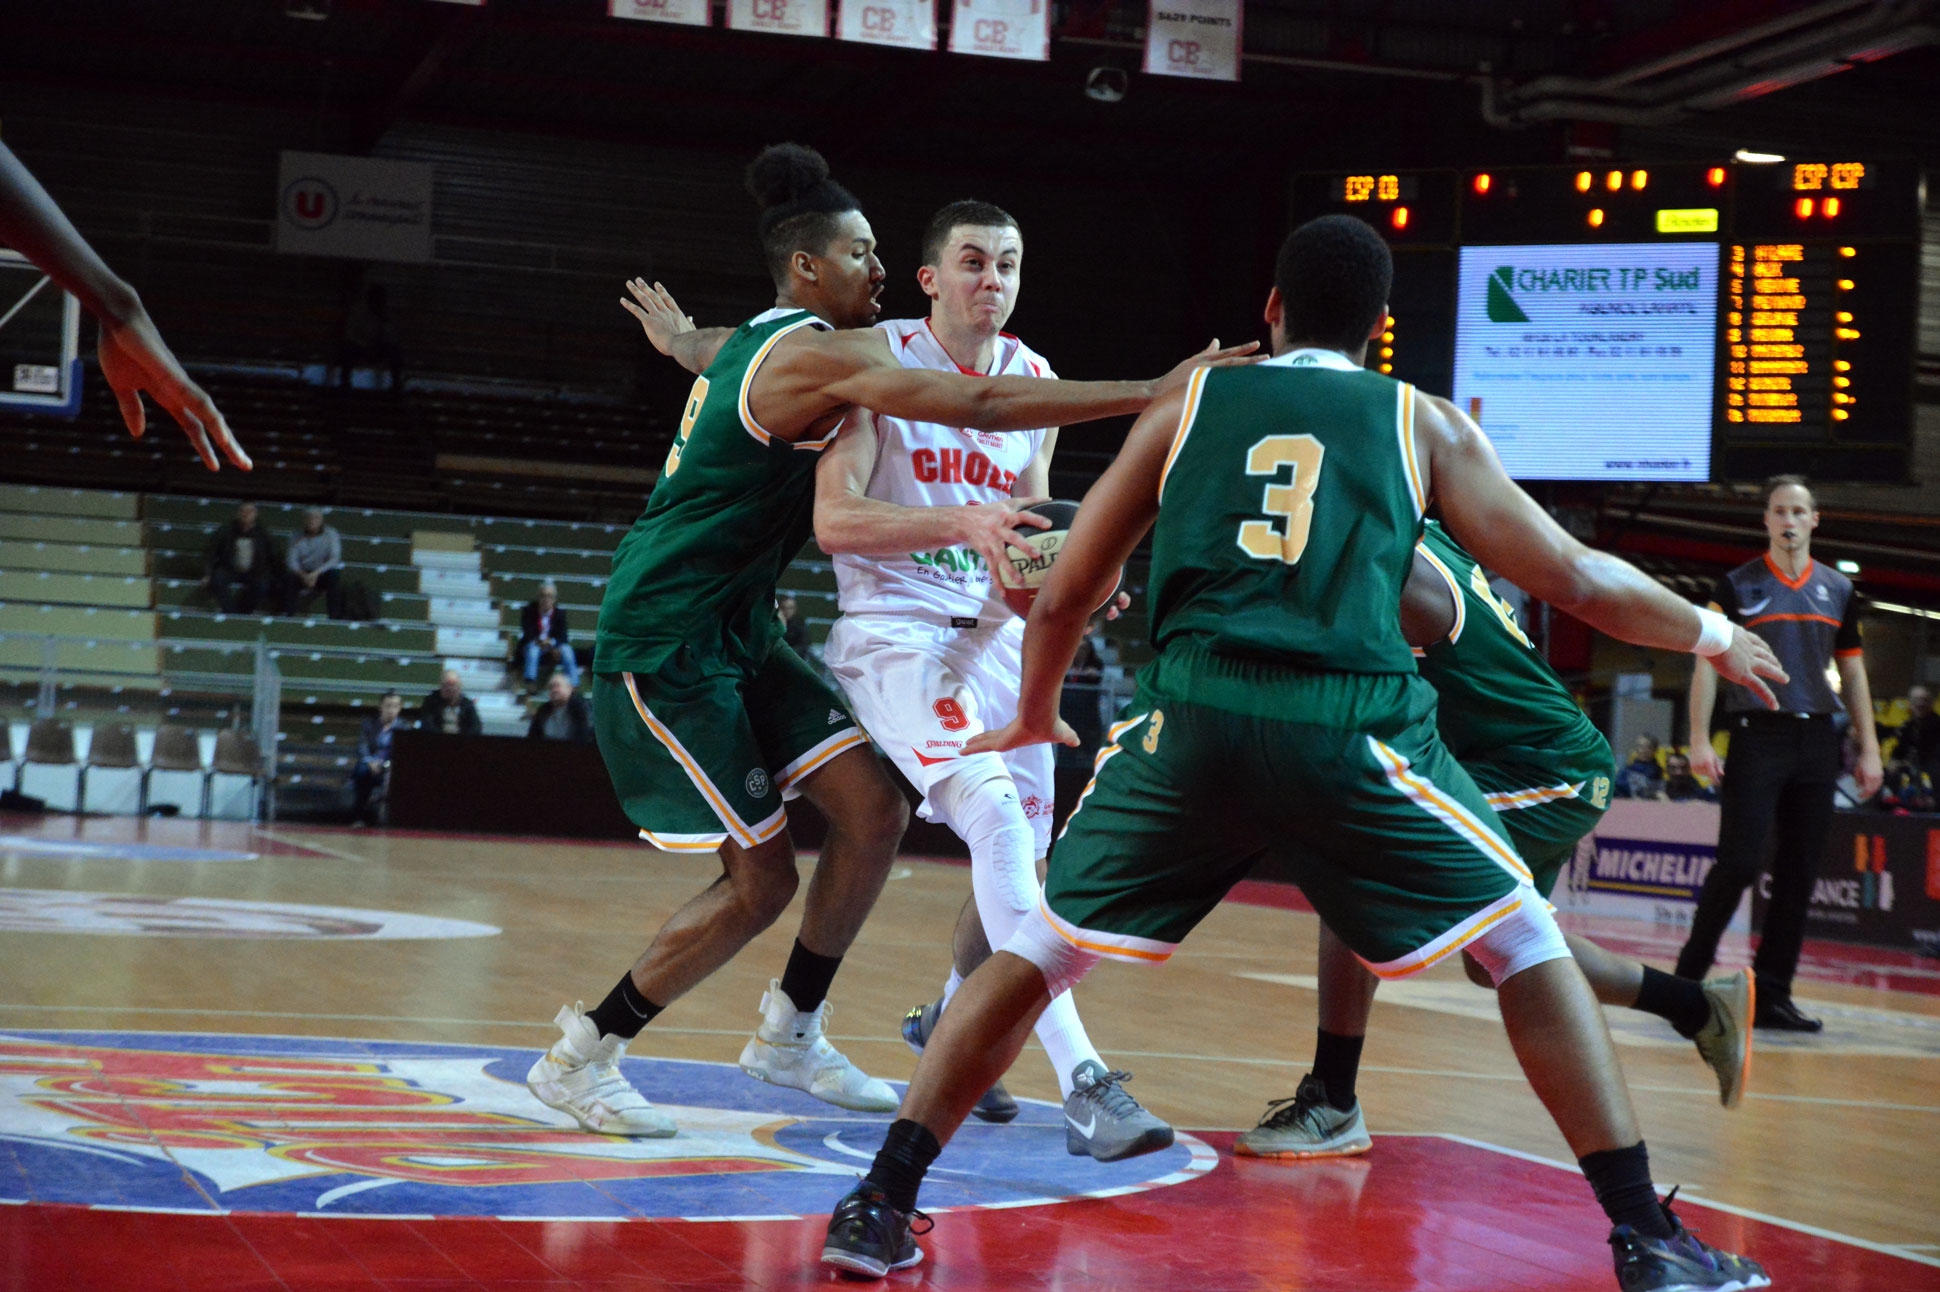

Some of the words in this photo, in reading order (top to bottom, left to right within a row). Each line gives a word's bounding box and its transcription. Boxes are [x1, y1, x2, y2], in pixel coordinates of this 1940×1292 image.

[1517, 269, 1611, 292] CHARIER
[1618, 268, 1648, 291] TP
[1654, 266, 1700, 291] Sud
[1236, 433, 1326, 566] 3
[932, 697, 970, 732] 9
[1142, 708, 1165, 755] 3
[925, 740, 963, 749] SPALDING
